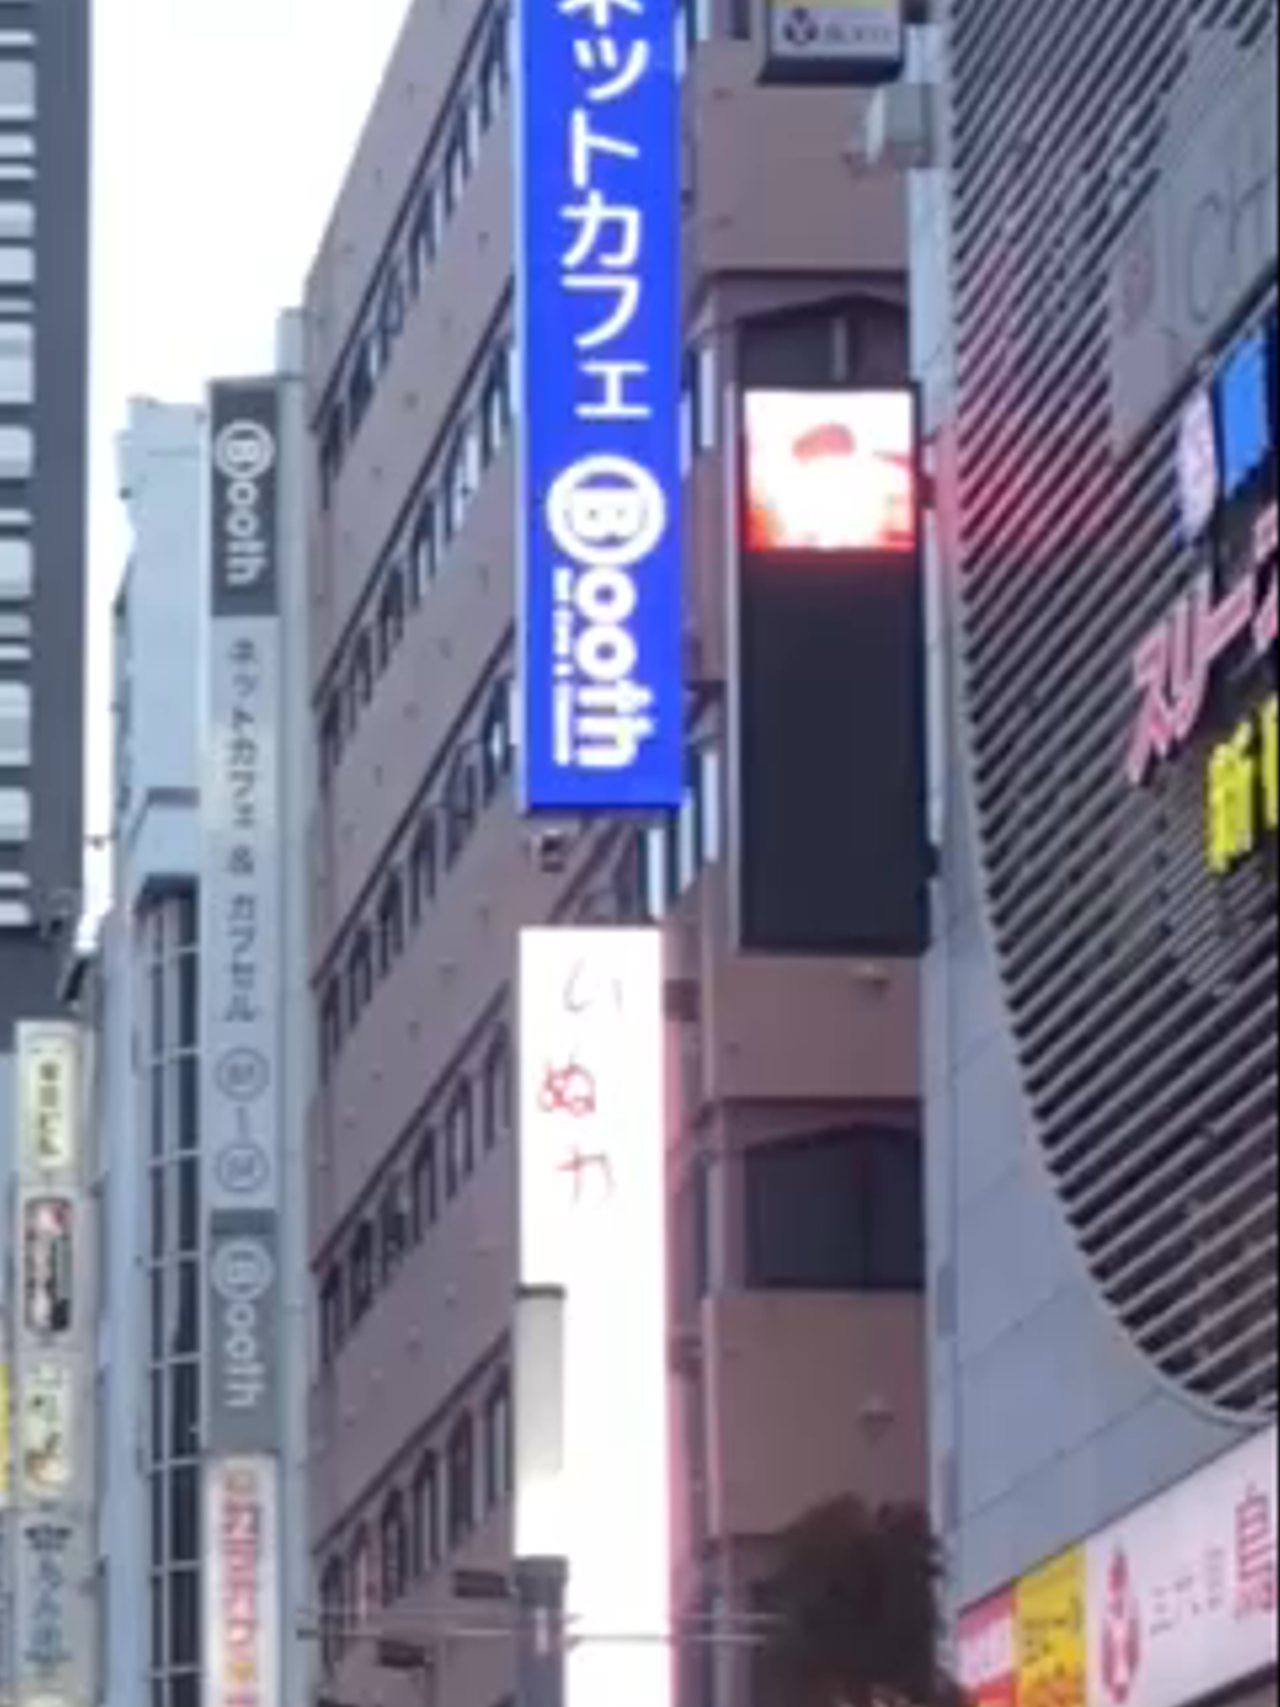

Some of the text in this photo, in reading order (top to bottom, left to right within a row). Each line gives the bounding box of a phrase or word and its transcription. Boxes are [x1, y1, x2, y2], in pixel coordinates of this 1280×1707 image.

[214, 419, 273, 587] Booth
[544, 453, 667, 767] Booth
[213, 1238, 273, 1410] Booth
